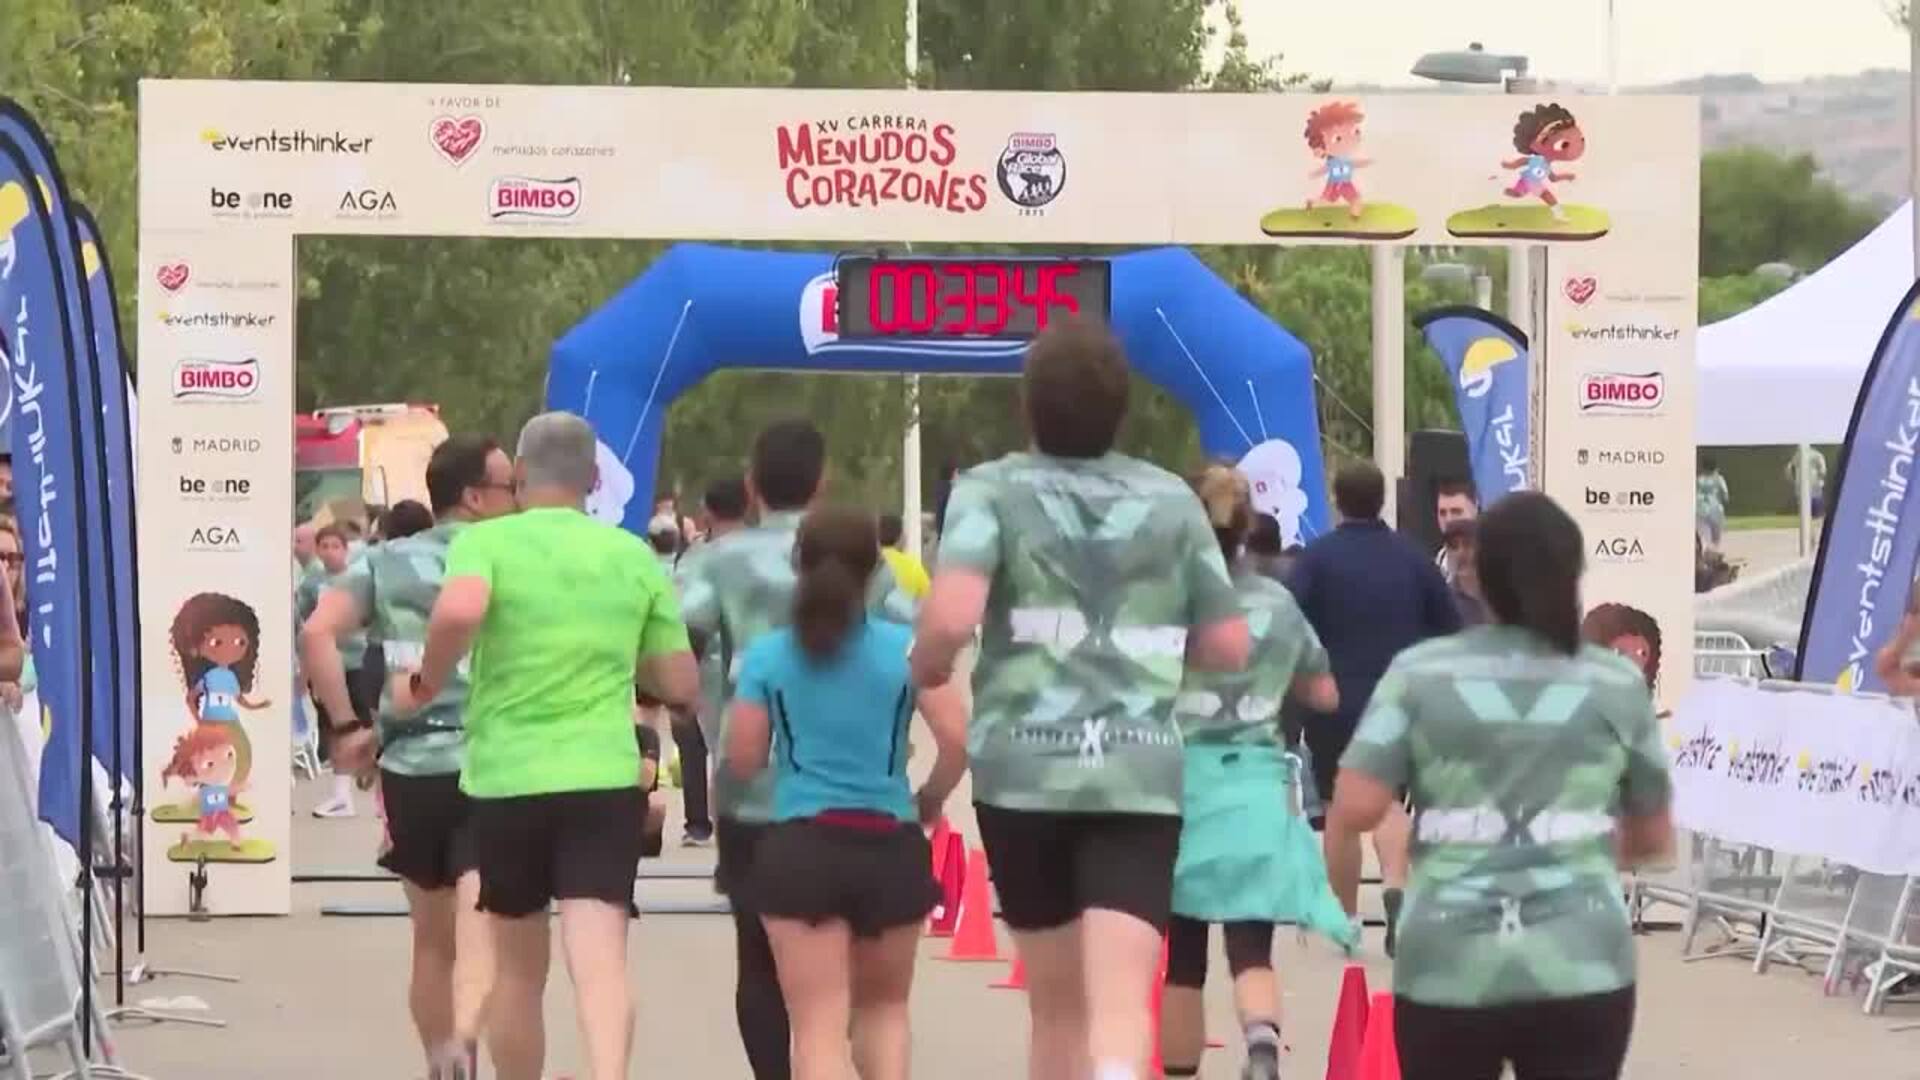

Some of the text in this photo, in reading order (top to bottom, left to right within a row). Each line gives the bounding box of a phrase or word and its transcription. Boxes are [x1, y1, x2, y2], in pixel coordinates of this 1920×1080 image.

[816, 113, 929, 134] XV CARRERA
[208, 128, 373, 154] eventsthinker
[776, 121, 957, 170] MENUDOS
[210, 186, 242, 209] be
[339, 189, 397, 211] AGA
[497, 188, 577, 209] BIMBO
[785, 167, 988, 213] CORAZONES
[162, 312, 276, 328] eventsthinker
[1570, 323, 1680, 340] eventsthinker
[180, 370, 254, 388] BIMBO
[1587, 382, 1659, 401] BIMBO
[192, 438, 262, 452] MADRID
[1598, 450, 1665, 465] MADRID
[179, 475, 206, 493] be
[1585, 486, 1611, 505] be
[190, 526, 241, 546] AGA
[1594, 537, 1645, 557] AGA
